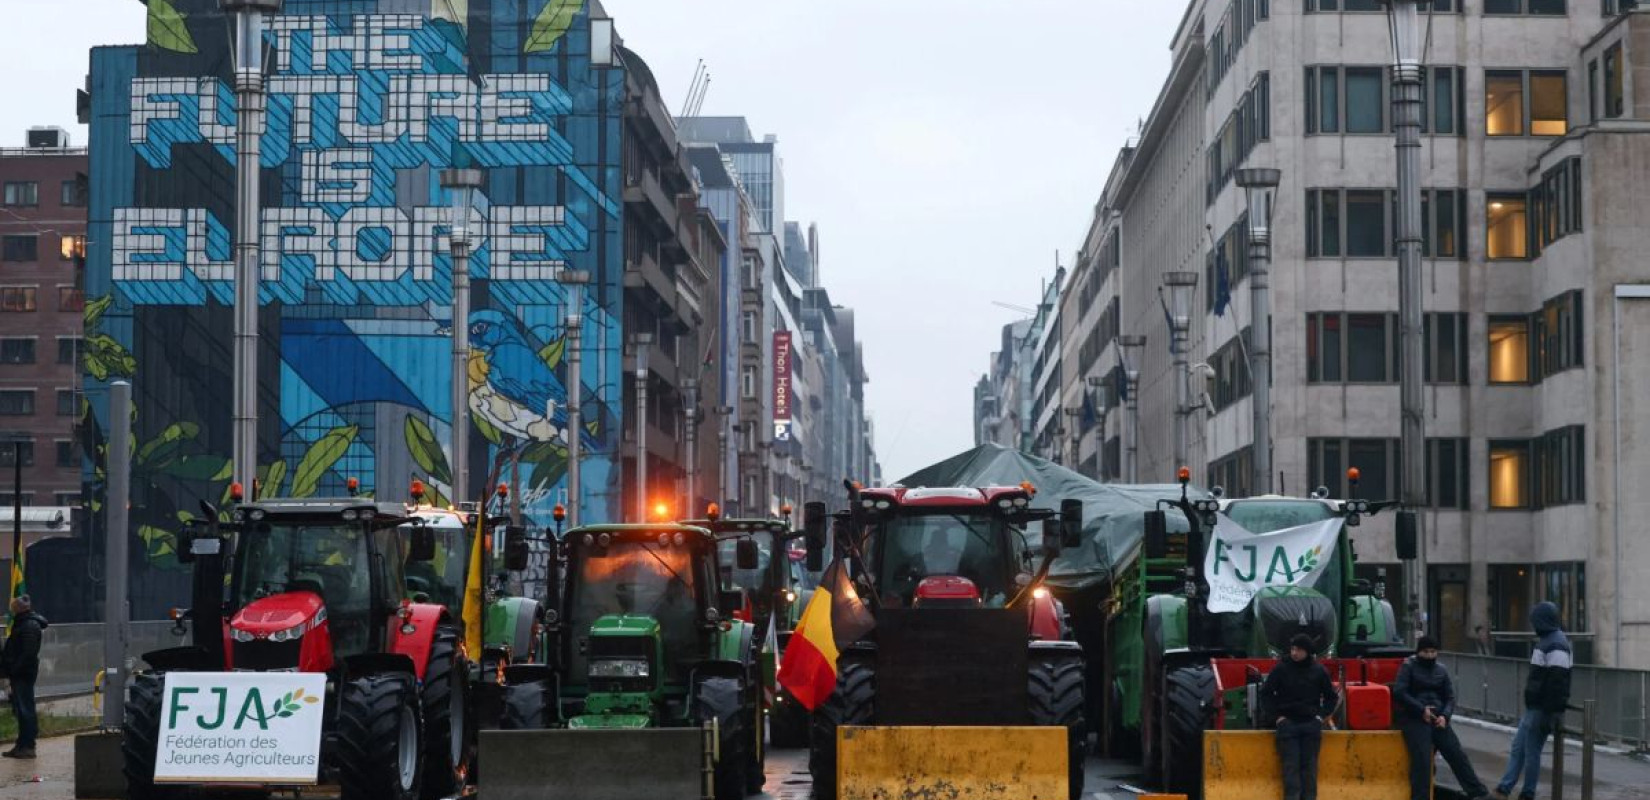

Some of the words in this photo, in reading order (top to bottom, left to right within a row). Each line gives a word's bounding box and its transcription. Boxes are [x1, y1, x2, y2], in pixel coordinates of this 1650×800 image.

[261, 14, 423, 70] THE
[130, 74, 549, 144] FUTURE
[301, 148, 373, 202] IS
[112, 206, 566, 281] EUROPE
[777, 343, 789, 373] Thon
[777, 378, 788, 415] Hotels
[1214, 538, 1294, 583] FJA
[169, 687, 268, 730] FJA
[165, 751, 220, 765] Jeunes
[224, 751, 315, 767] Agriculteurs
[166, 735, 246, 749] Fédération
[250, 735, 278, 749] des
